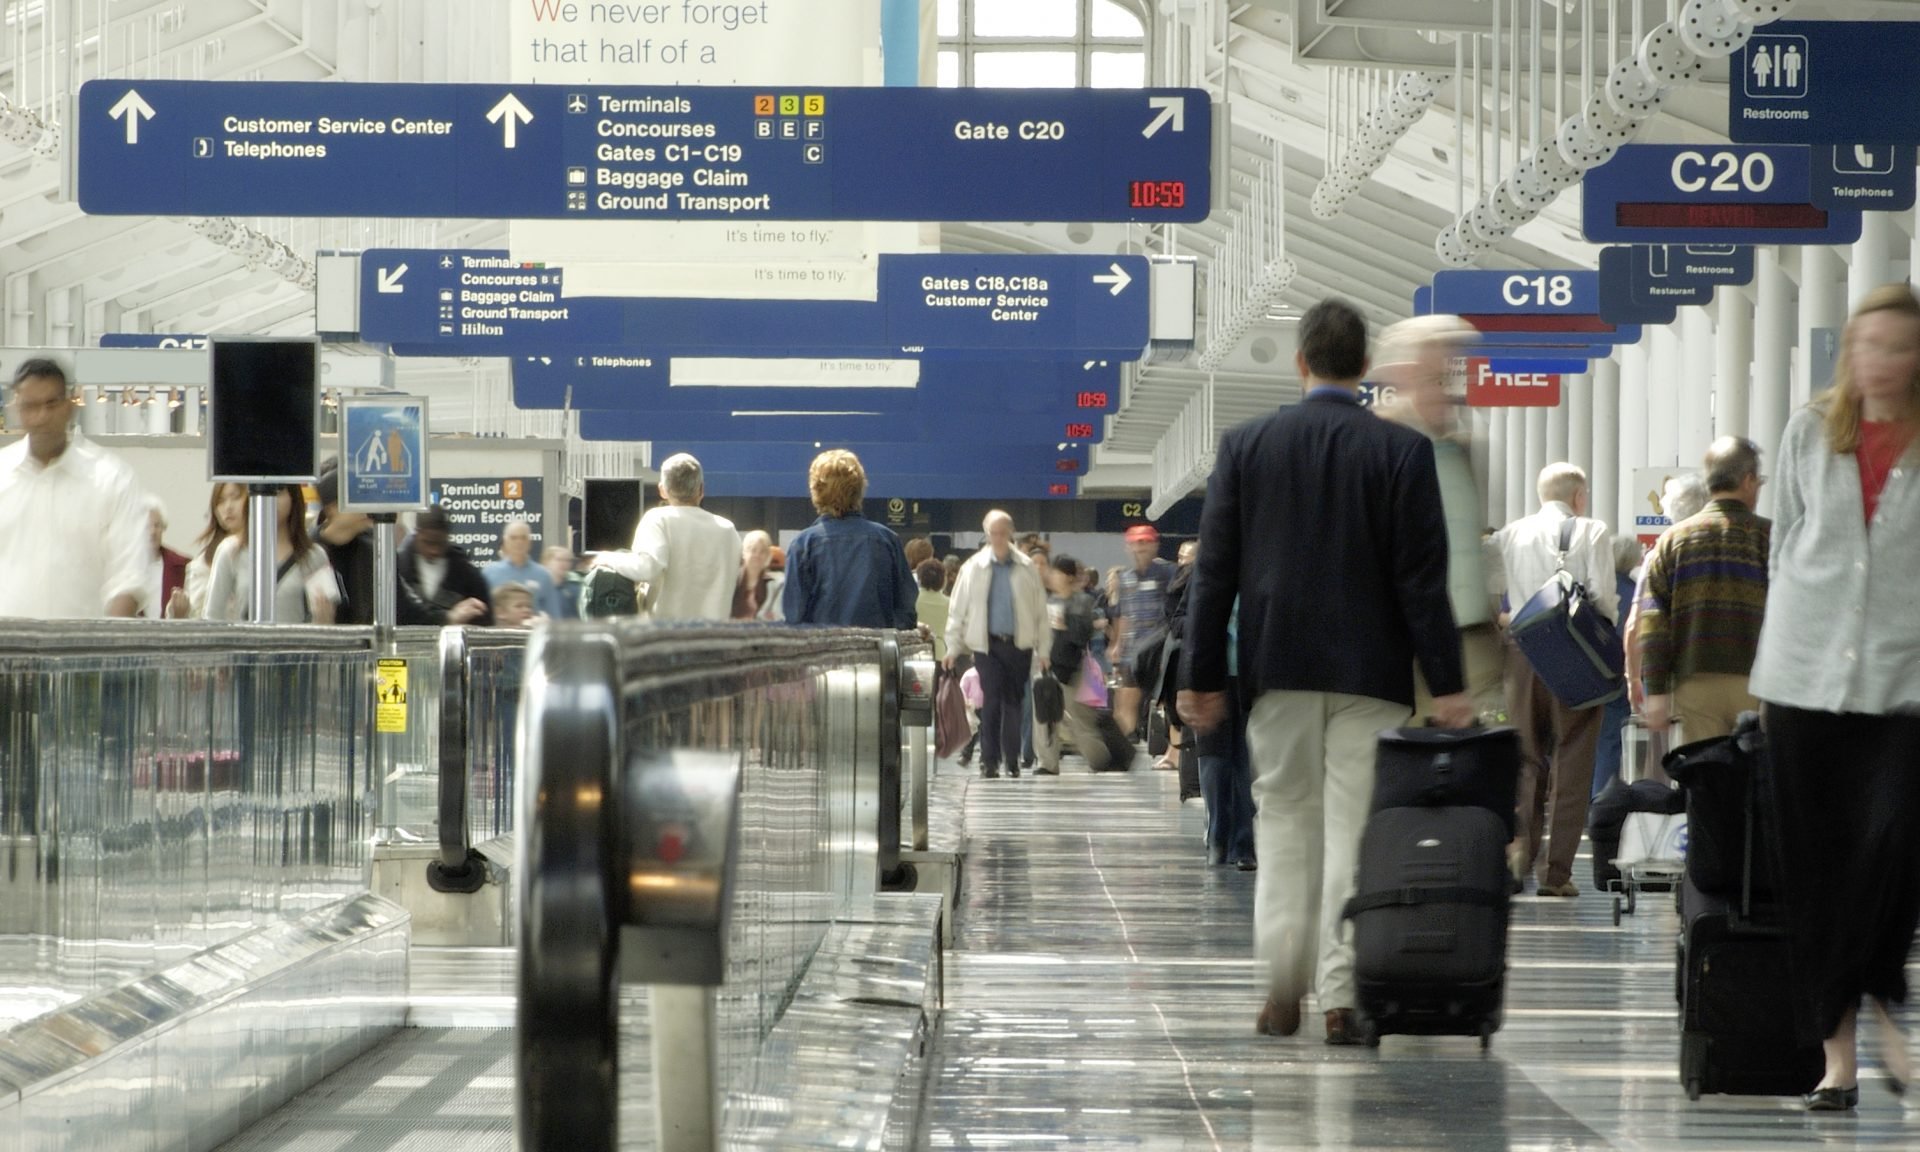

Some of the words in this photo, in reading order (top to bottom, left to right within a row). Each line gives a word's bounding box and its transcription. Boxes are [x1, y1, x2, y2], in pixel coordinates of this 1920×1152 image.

[532, 0, 578, 22] We
[590, 4, 671, 24] never
[682, 0, 768, 31] forget
[531, 38, 588, 63] that
[600, 38, 651, 63] half
[661, 39, 688, 64] of
[699, 45, 717, 64] a
[598, 96, 692, 114] Terminals
[758, 97, 770, 113] 2
[784, 97, 796, 113] 3
[808, 97, 820, 113] 5
[1743, 108, 1810, 121] Restrooms
[223, 117, 312, 134] Customer
[318, 117, 385, 135] Service
[391, 118, 453, 136] Center
[597, 121, 716, 139] Concourses
[757, 122, 770, 138] B
[783, 122, 795, 138] E
[808, 123, 819, 138] F
[954, 121, 1009, 140] Gate
[1018, 121, 1064, 141] C20
[224, 141, 327, 160] Telephones
[597, 144, 656, 162] Gates
[664, 145, 742, 163] C1-C19
[806, 146, 820, 162] C
[597, 168, 684, 189] Baggage
[693, 169, 748, 187] Claim
[1671, 151, 1775, 193] C20
[1131, 182, 1184, 207] 10:59
[1832, 186, 1894, 199] Telephones
[597, 193, 668, 212] Ground
[676, 194, 770, 213] Transport
[727, 230, 747, 242] It's
[753, 230, 785, 242] time
[791, 231, 806, 242] to
[754, 269, 774, 280] It's
[778, 269, 807, 280] time
[812, 270, 824, 280] to
[1686, 265, 1734, 274] Restrooms
[461, 273, 537, 285] Concourses
[921, 276, 970, 291] Gates
[975, 276, 1048, 292] C18,C18a
[461, 290, 517, 304] Baggage
[519, 291, 554, 302] Claim
[1502, 275, 1573, 306] C18
[1649, 287, 1696, 295] Restaurant
[925, 294, 992, 306] Customer
[996, 294, 1048, 307] Service
[461, 307, 507, 319] Ground
[509, 307, 568, 321] Transport
[991, 308, 1038, 321] Center
[461, 323, 503, 335] Hilton
[592, 357, 652, 368] Telephones
[1477, 363, 1549, 387] FREE
[1077, 392, 1107, 408] 10:59
[441, 483, 500, 496] Terminal
[507, 482, 519, 496] 2
[440, 497, 525, 510] Concourse
[449, 513, 476, 523] own
[480, 511, 542, 523] Escalator
[448, 533, 498, 544] aggage
[473, 547, 495, 556] Side
